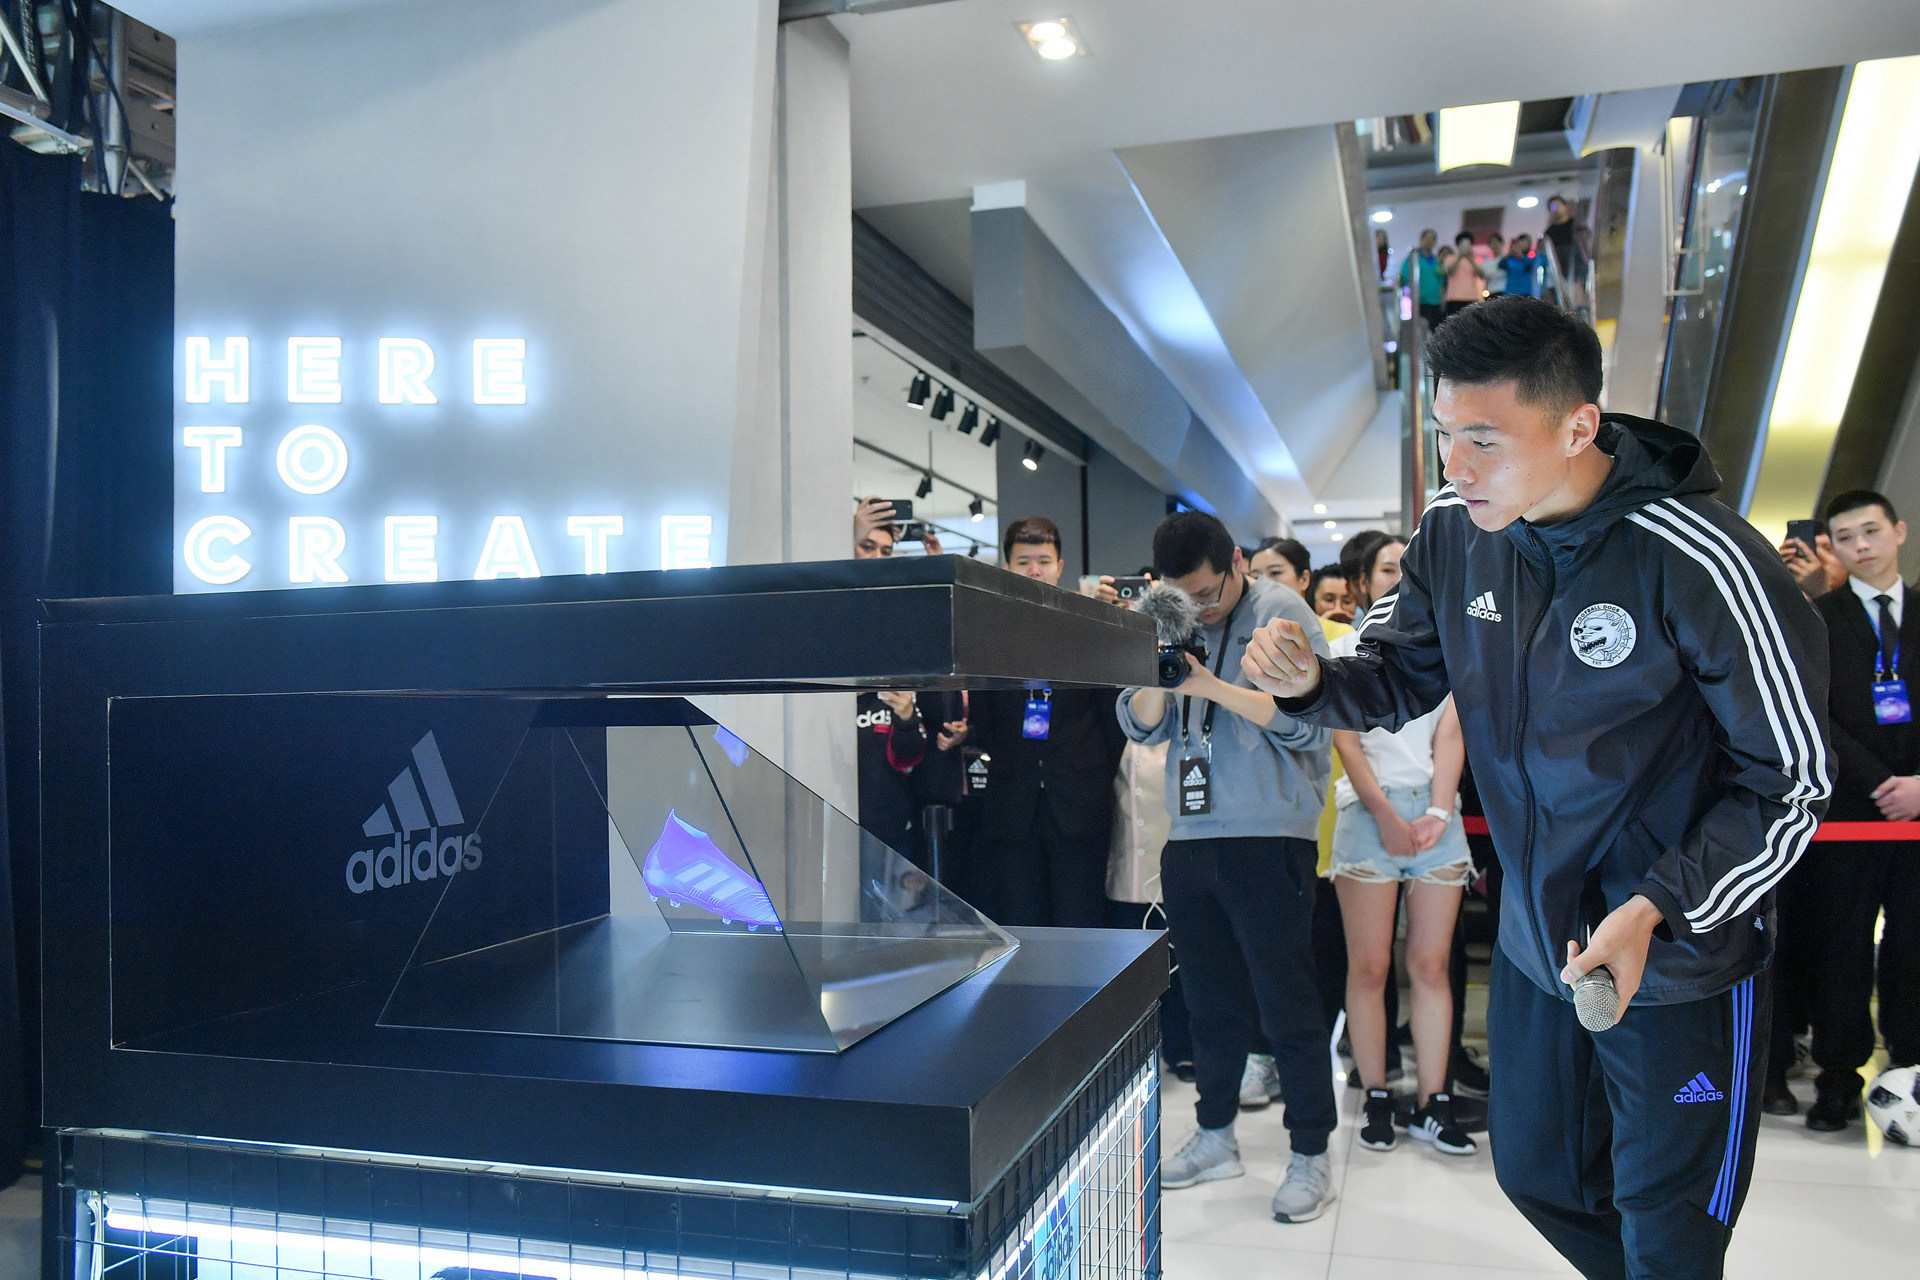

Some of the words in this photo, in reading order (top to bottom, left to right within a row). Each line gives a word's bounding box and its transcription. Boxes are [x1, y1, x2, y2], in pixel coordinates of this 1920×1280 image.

[185, 336, 526, 404] HERE
[183, 424, 348, 494] TO
[183, 515, 712, 584] CREATE
[1466, 606, 1502, 623] adidas
[346, 826, 483, 894] adidas
[1673, 1090, 1724, 1103] adidas
